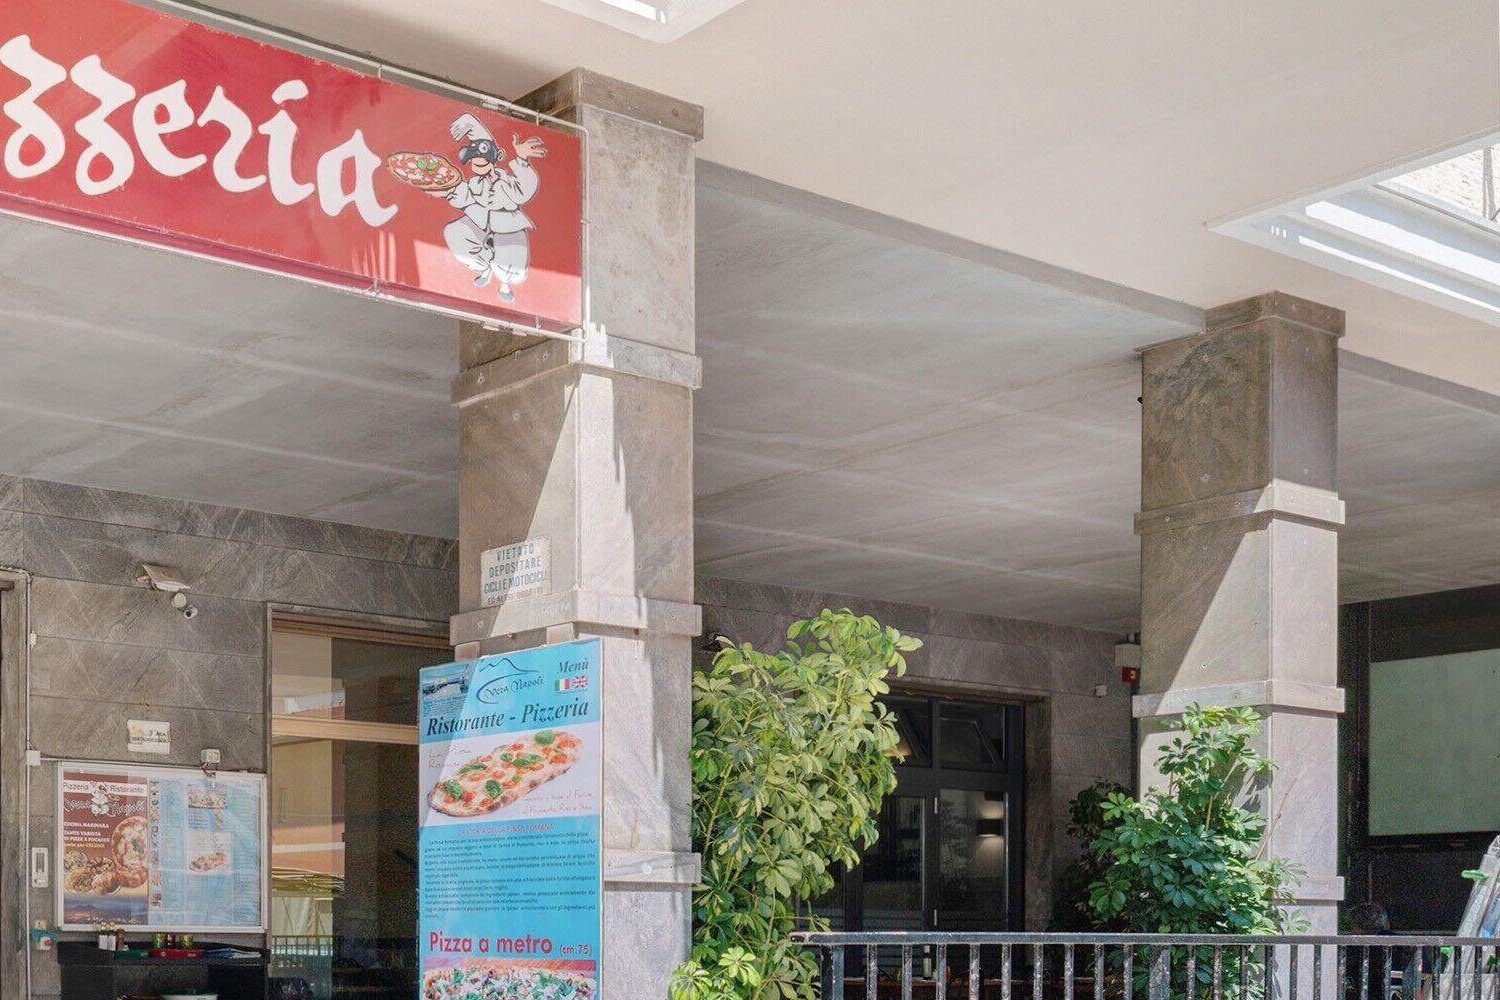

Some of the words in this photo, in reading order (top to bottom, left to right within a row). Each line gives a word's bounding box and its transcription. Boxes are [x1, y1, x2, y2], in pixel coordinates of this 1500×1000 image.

[496, 543, 535, 562] VIETATO
[488, 556, 541, 579] DEPOSITARE
[557, 658, 590, 674] Menù
[510, 675, 544, 693] Napoli
[426, 713, 506, 737] Ristorante
[522, 697, 590, 725] Pizzeria
[63, 781, 90, 791] Pizzeria
[110, 784, 145, 794] Ristorante
[429, 930, 472, 954] Pizza
[478, 940, 489, 954] a
[496, 935, 553, 954] metro
